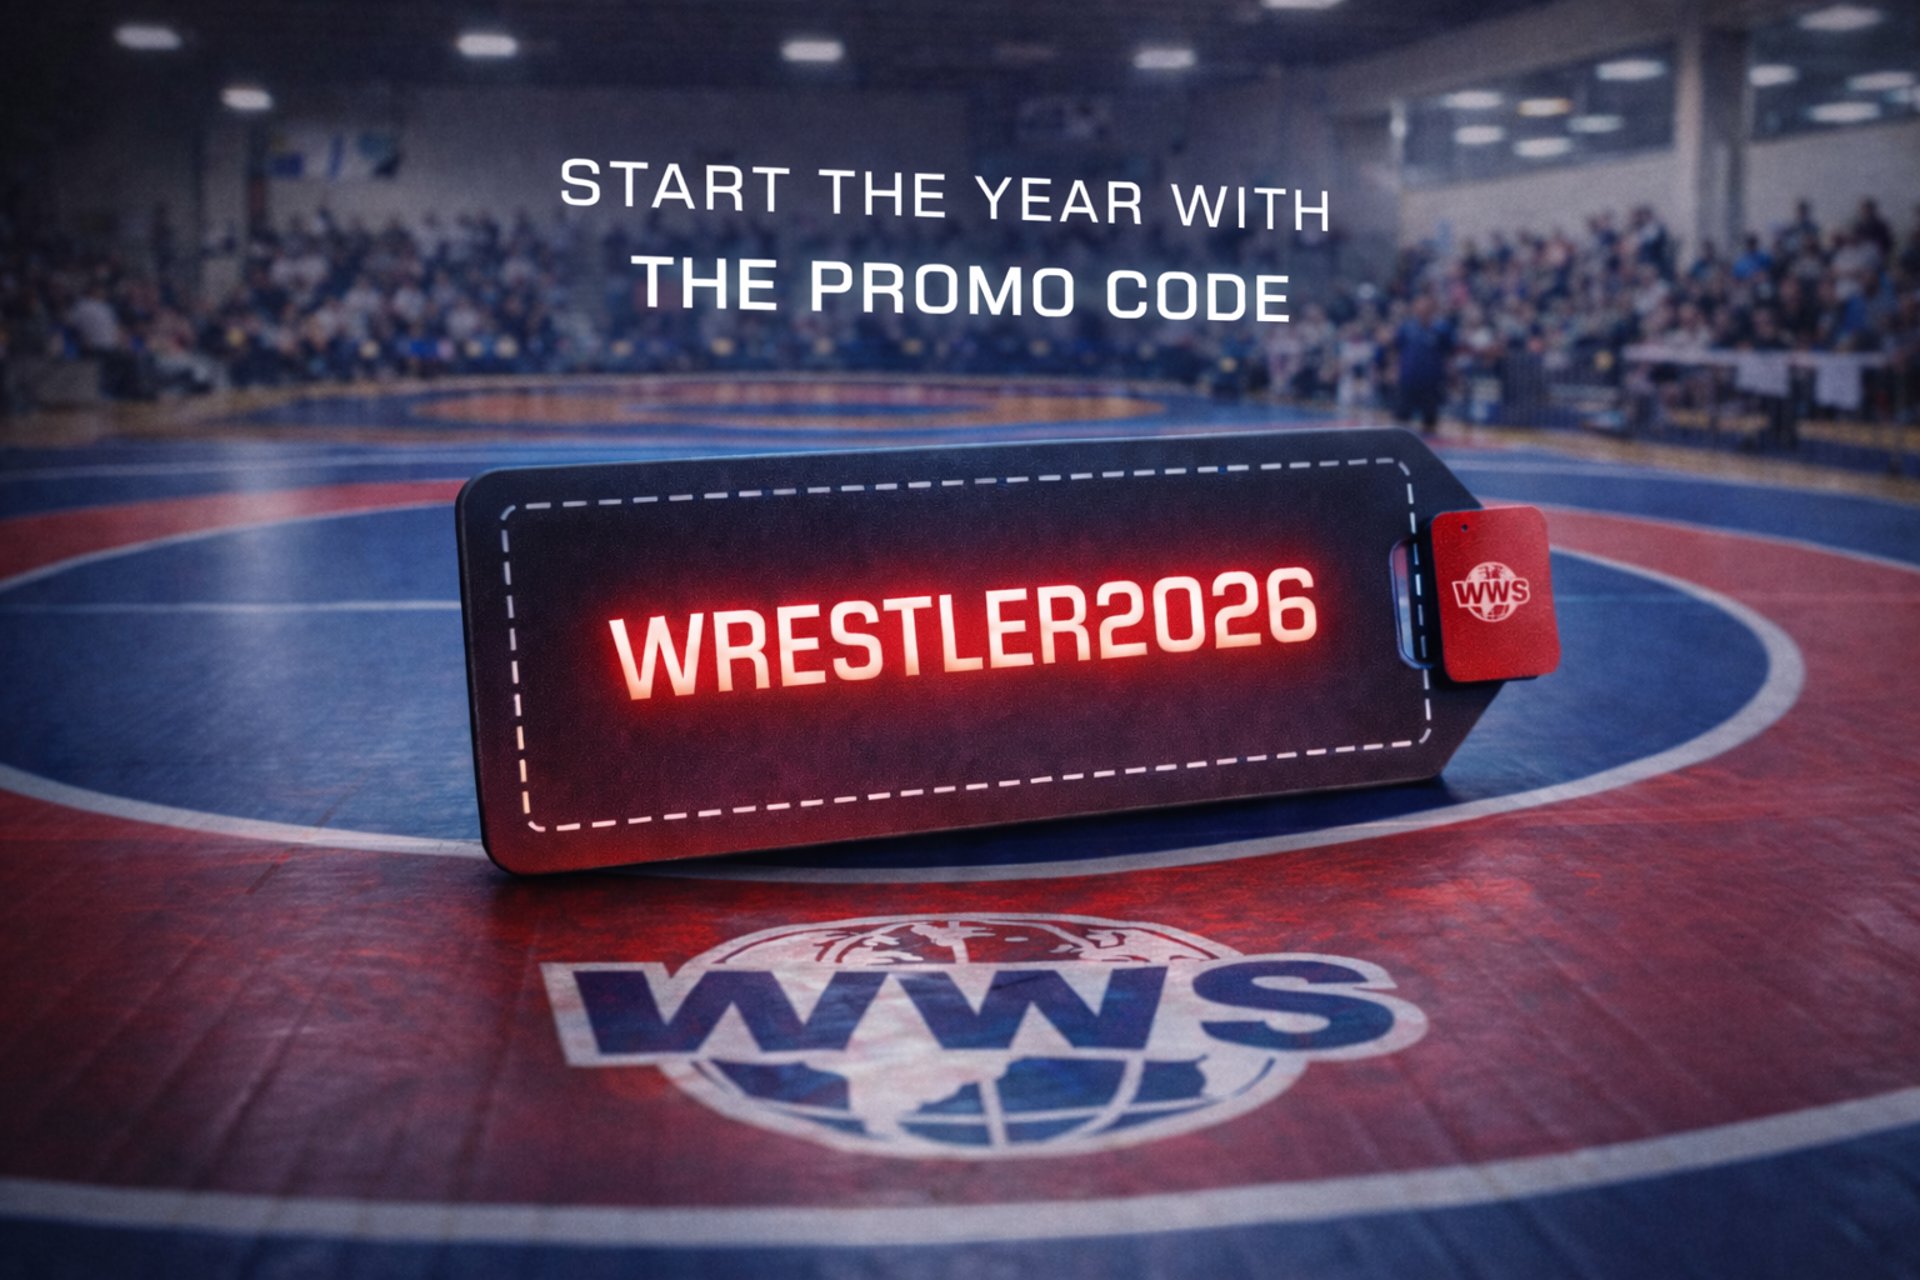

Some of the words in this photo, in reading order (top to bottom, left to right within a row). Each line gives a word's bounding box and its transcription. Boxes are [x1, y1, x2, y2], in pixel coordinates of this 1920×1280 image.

[608, 566, 1317, 699] WRESTLER2026
[1454, 580, 1528, 605] WWS
[570, 960, 1398, 1053] WWS
